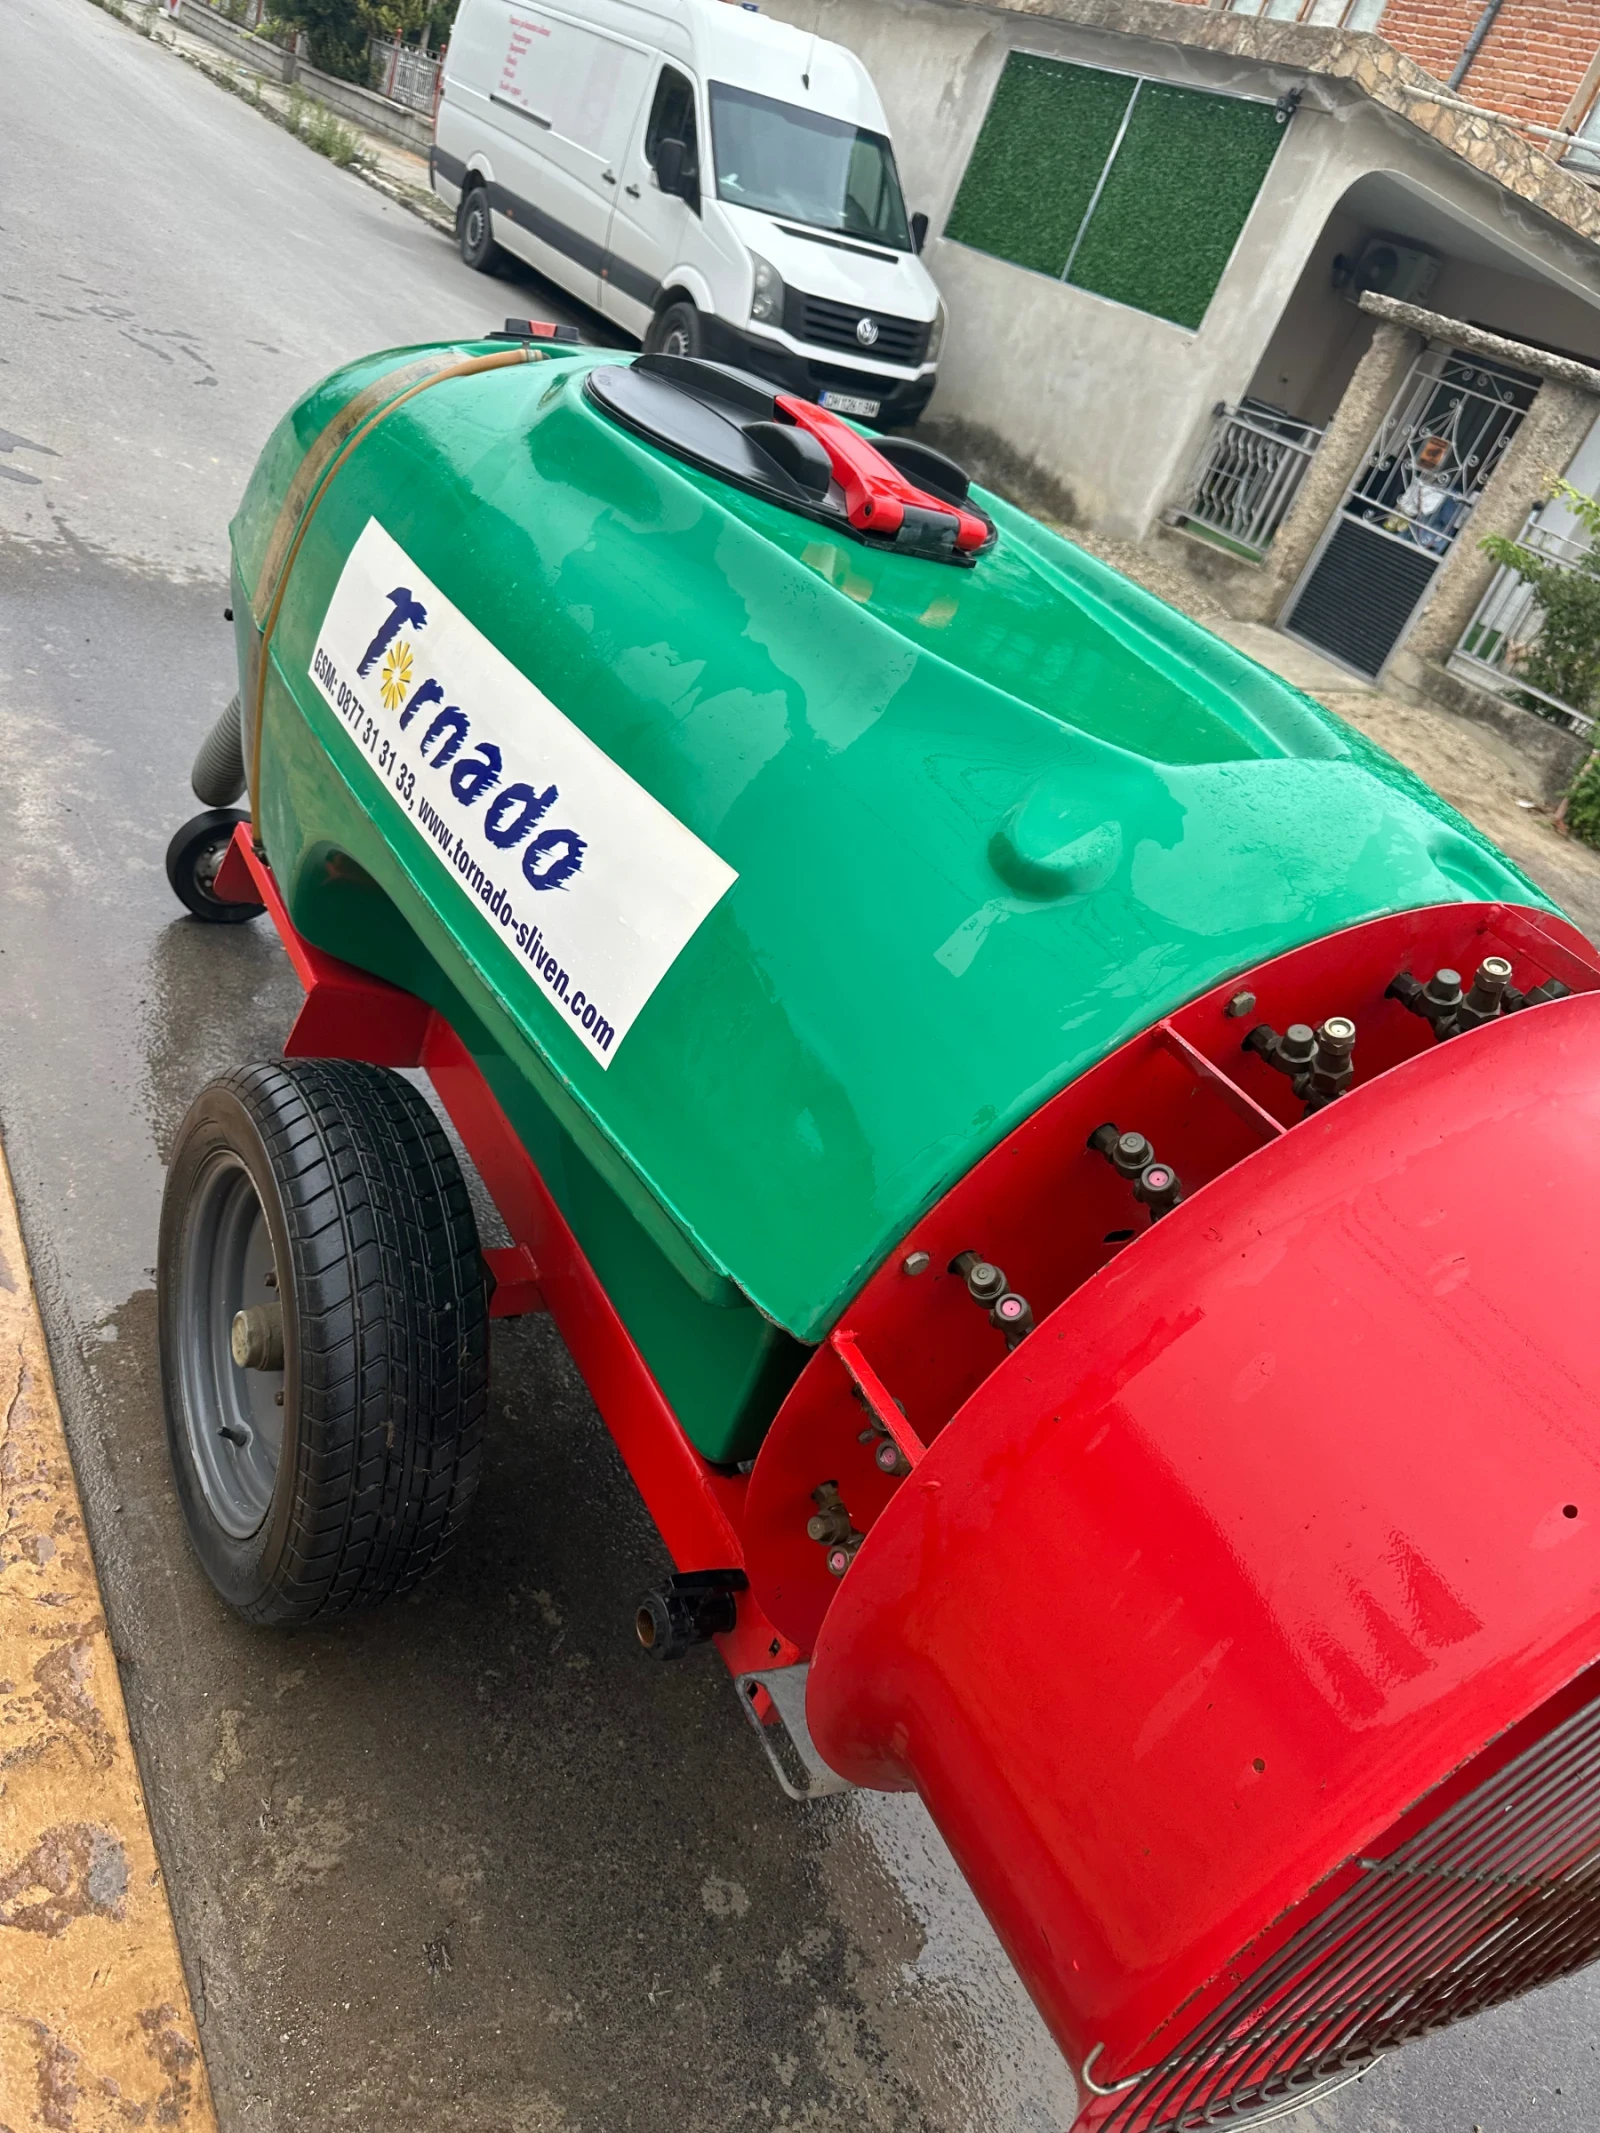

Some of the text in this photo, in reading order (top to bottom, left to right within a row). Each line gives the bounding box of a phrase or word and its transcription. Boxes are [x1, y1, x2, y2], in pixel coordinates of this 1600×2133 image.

[314, 648, 615, 1052] GSM: 0877 31 31 33, www.tornado-sliven.com
